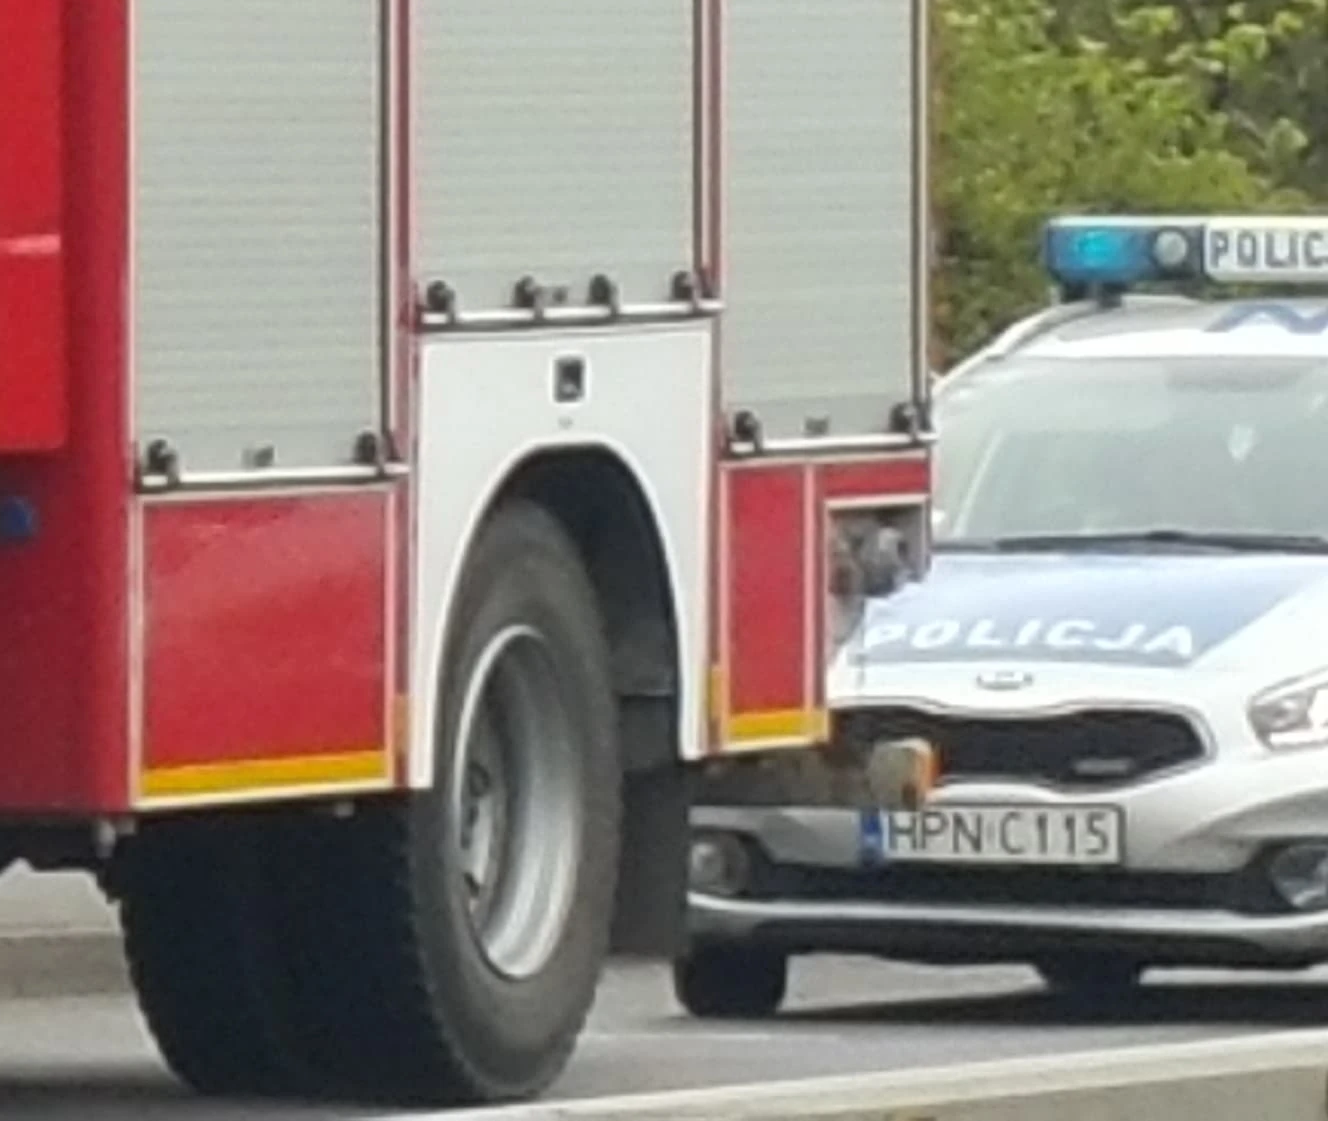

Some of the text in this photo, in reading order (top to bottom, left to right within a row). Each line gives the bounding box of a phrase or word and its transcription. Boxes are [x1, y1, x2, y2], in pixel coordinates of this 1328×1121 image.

[1209, 230, 1328, 269] POLIC
[864, 620, 1193, 656] POLICJA
[888, 810, 1110, 856] HPN C115
